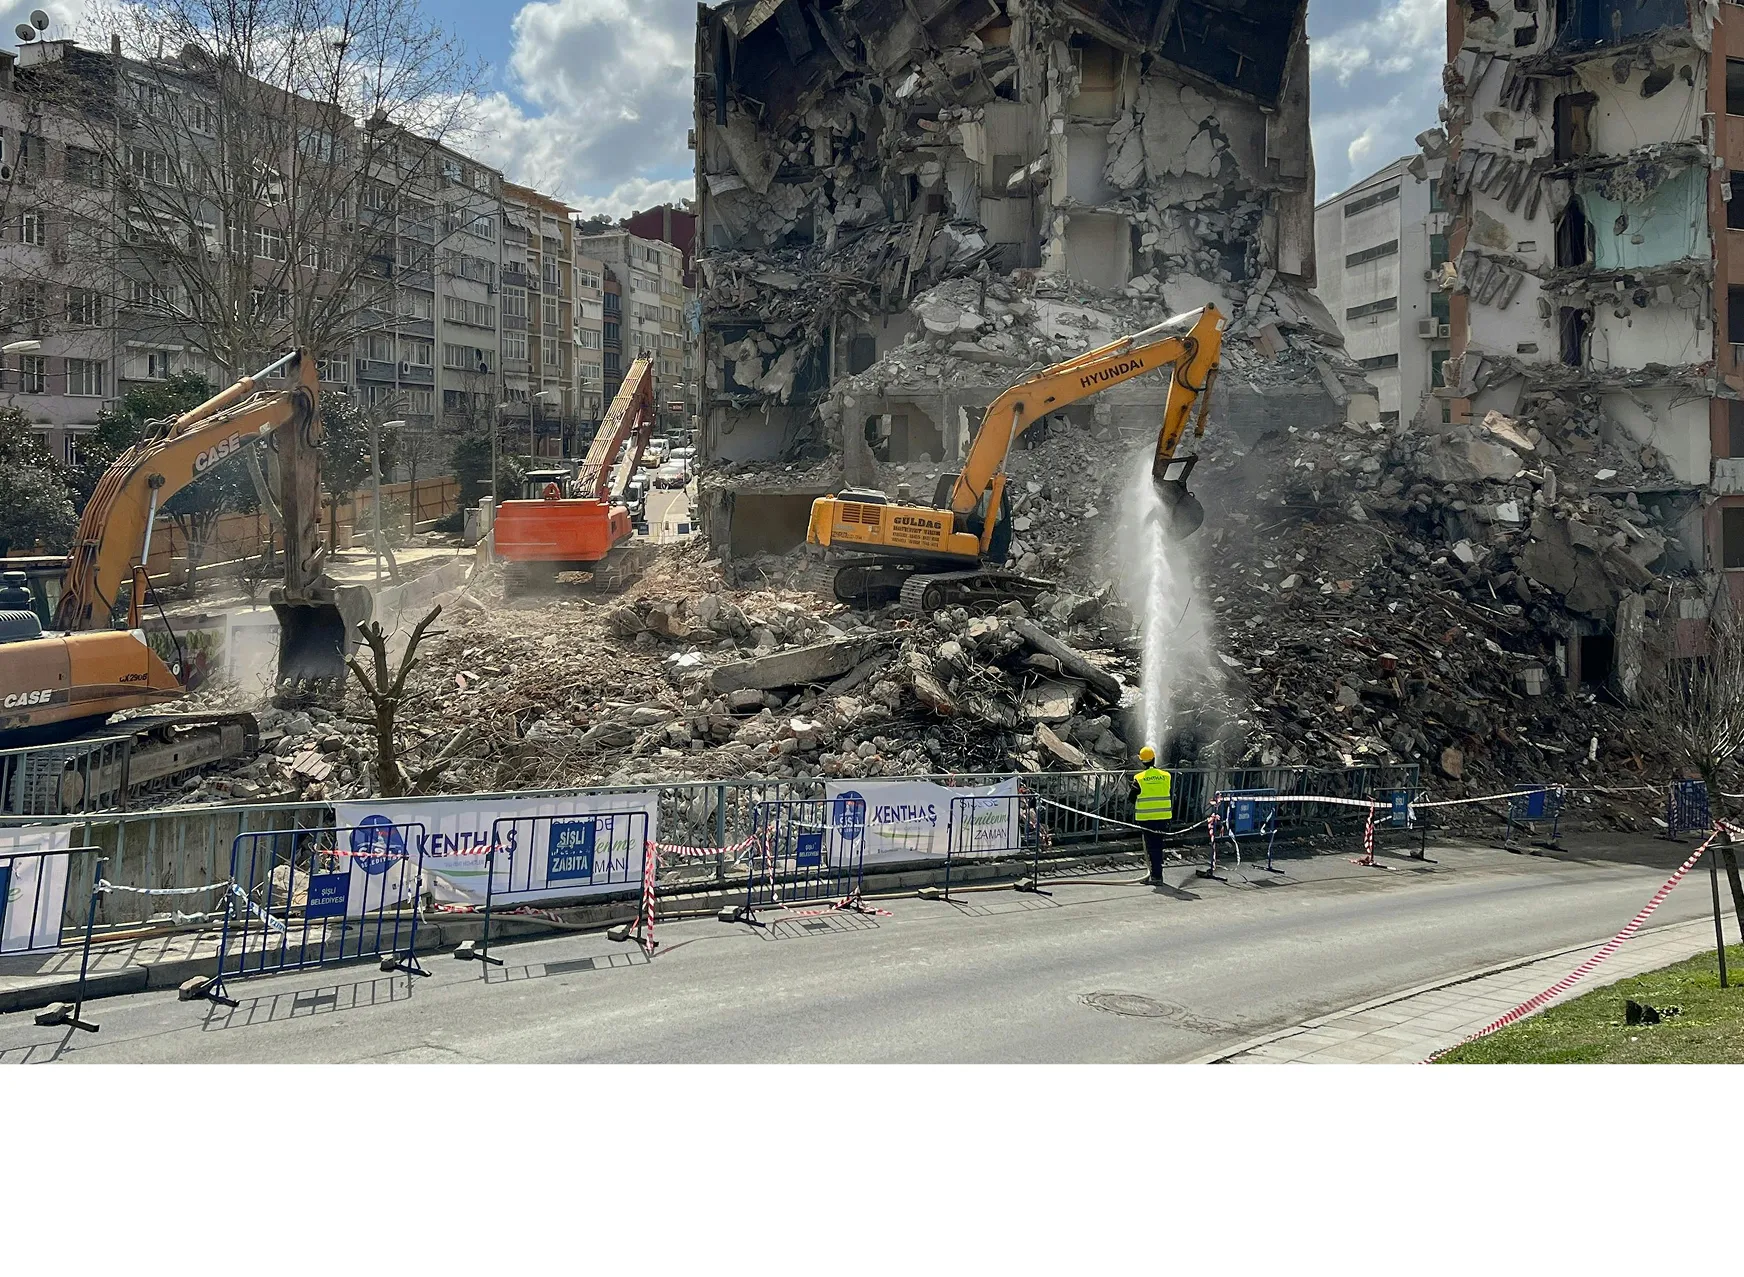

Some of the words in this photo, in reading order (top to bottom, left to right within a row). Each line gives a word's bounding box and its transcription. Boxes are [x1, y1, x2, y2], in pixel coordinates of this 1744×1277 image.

[1080, 359, 1144, 388] HYUNDAI
[195, 432, 240, 471] CASE
[4, 689, 52, 708] CASE
[872, 804, 937, 827] KENTHAŞ
[560, 826, 586, 848] ŞİŞLİ
[551, 855, 588, 873] ZABITA
[310, 896, 345, 906] BELEDİYESİ
[321, 886, 337, 897] ŞİŞLİ
